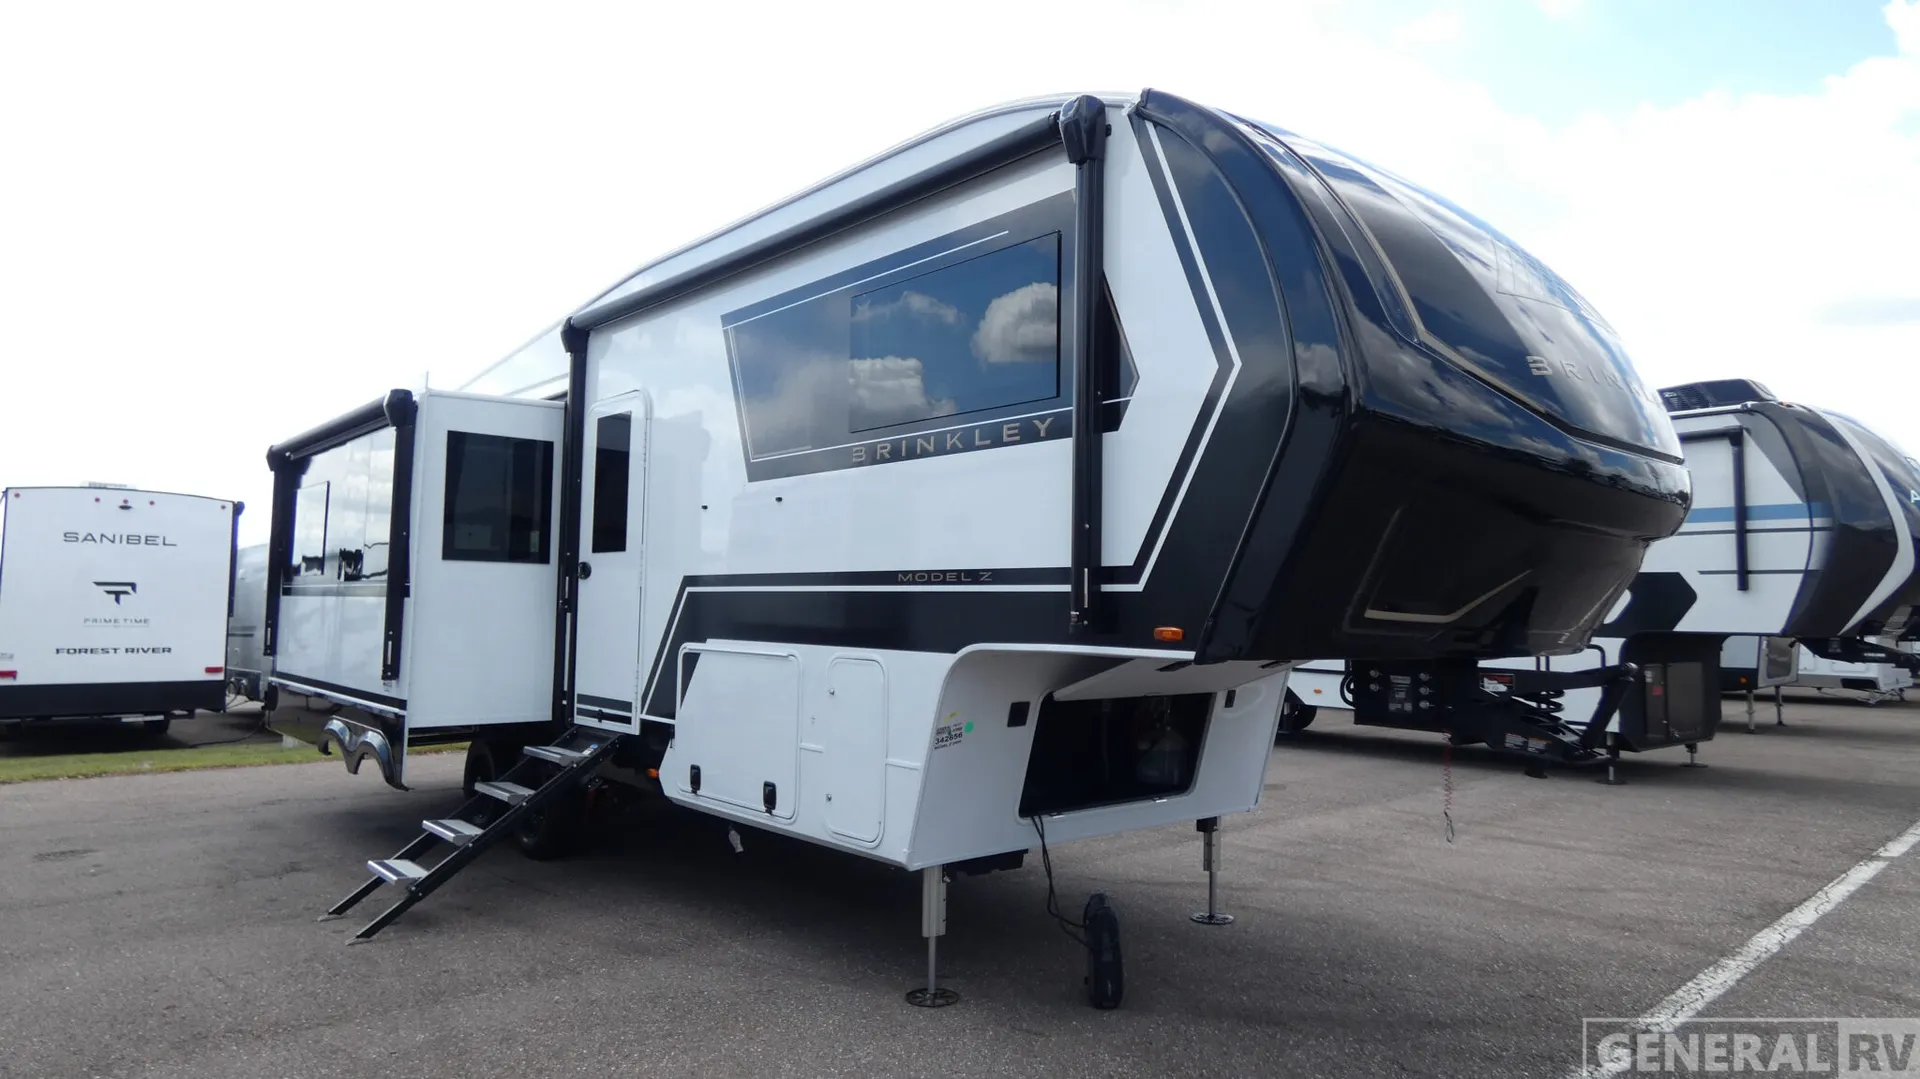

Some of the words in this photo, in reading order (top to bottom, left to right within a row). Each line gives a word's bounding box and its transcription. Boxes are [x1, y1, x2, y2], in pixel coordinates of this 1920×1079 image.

[852, 417, 1054, 463] BRINKLEY
[63, 532, 177, 546] SANIBEL
[898, 572, 972, 582] MODEL
[979, 571, 992, 581] Z
[55, 647, 120, 655] FOREST
